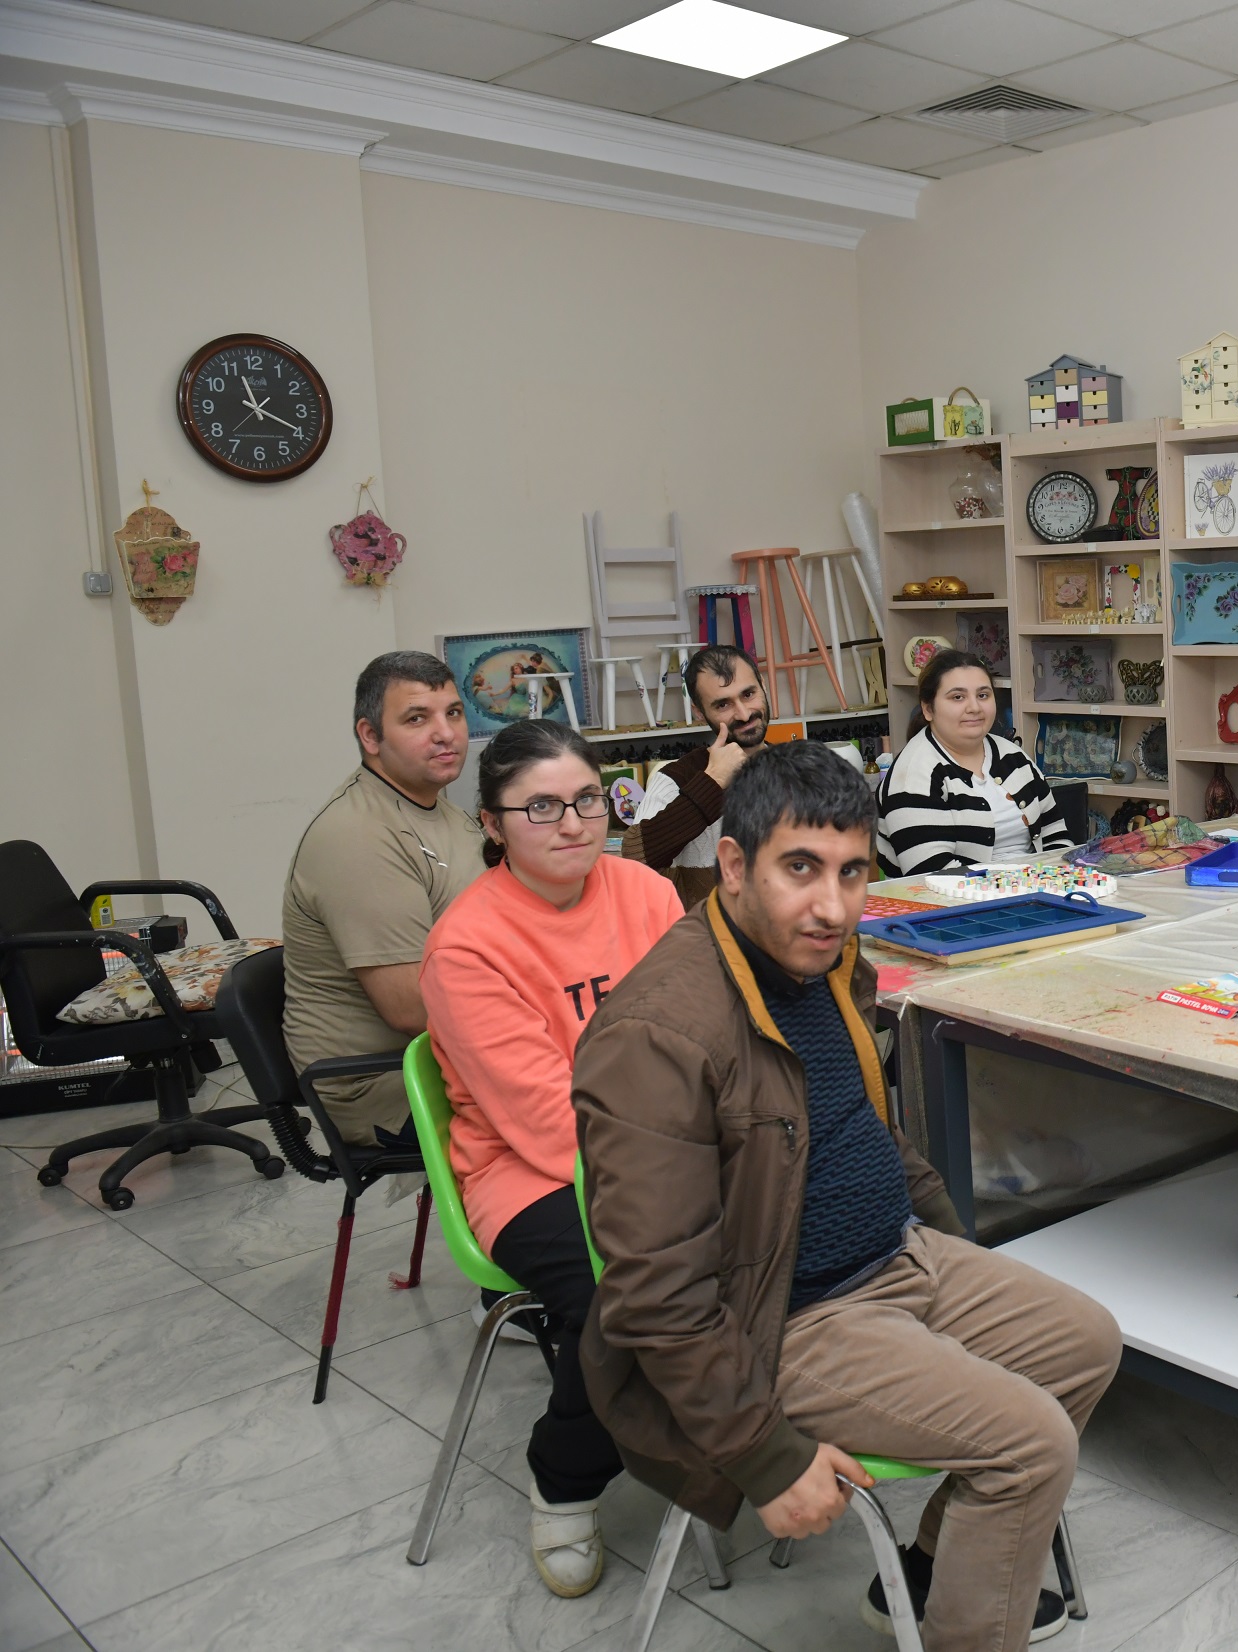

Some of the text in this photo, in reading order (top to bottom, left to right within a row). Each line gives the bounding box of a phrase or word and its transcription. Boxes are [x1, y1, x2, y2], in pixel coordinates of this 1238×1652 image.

[221, 361, 238, 376] 11
[243, 355, 263, 371] 12
[273, 363, 282, 378] 1
[205, 377, 225, 393] 10
[288, 381, 300, 395] 2
[202, 400, 215, 414] 9
[295, 404, 308, 418] 3
[211, 422, 223, 437] 8
[292, 426, 305, 440] 4
[228, 439, 240, 453] 7
[278, 441, 290, 455] 5
[253, 446, 266, 461] 6
[1059, 482, 1068, 490] 12
[1079, 493, 1085, 501] 2
[1038, 503, 1044, 511] 9
[1080, 504, 1087, 512] 3
[1040, 514, 1046, 522] 8
[1057, 526, 1064, 534] 6
[1069, 523, 1075, 531] 5
[1179, 998, 1202, 1009] PASTEL
[1201, 1003, 1219, 1013] BOYA
[58, 1082, 92, 1090] KUMTEL
